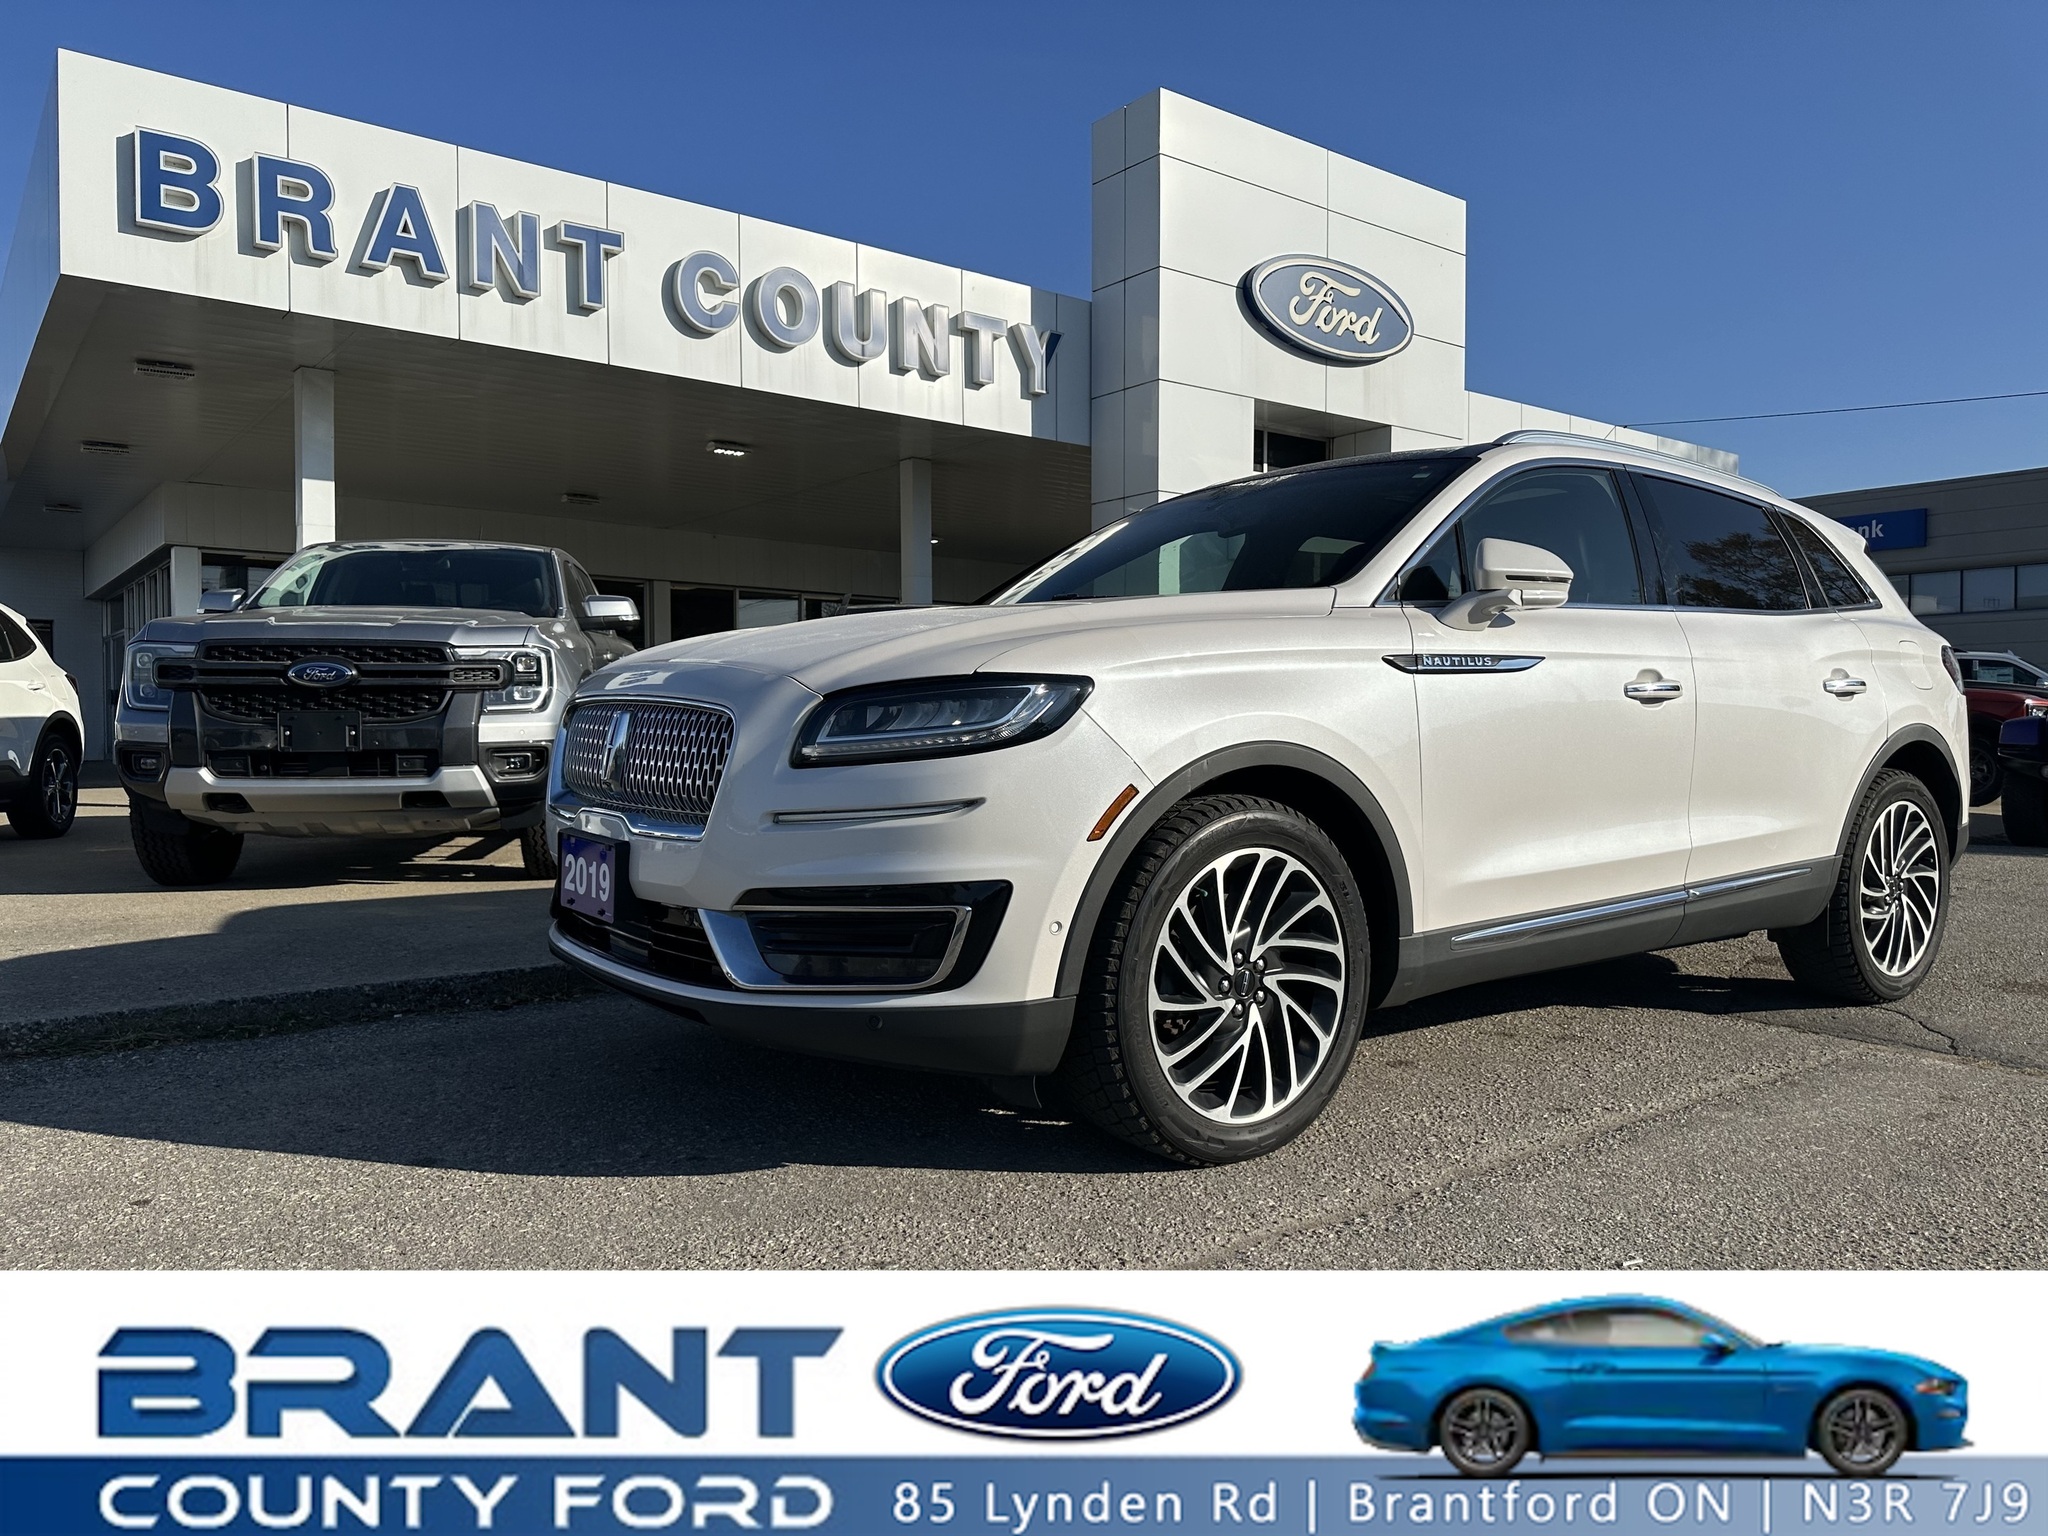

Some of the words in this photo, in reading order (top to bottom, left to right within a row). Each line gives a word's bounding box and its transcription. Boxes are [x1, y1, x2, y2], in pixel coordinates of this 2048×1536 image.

[134, 126, 625, 311] BRANT
[673, 250, 1064, 396] COUNTY
[1288, 271, 1384, 346] Ford
[1851, 520, 1885, 539] nk
[303, 666, 337, 681] Ford
[1422, 655, 1493, 667] NAUTILUS
[564, 853, 611, 902] 2019
